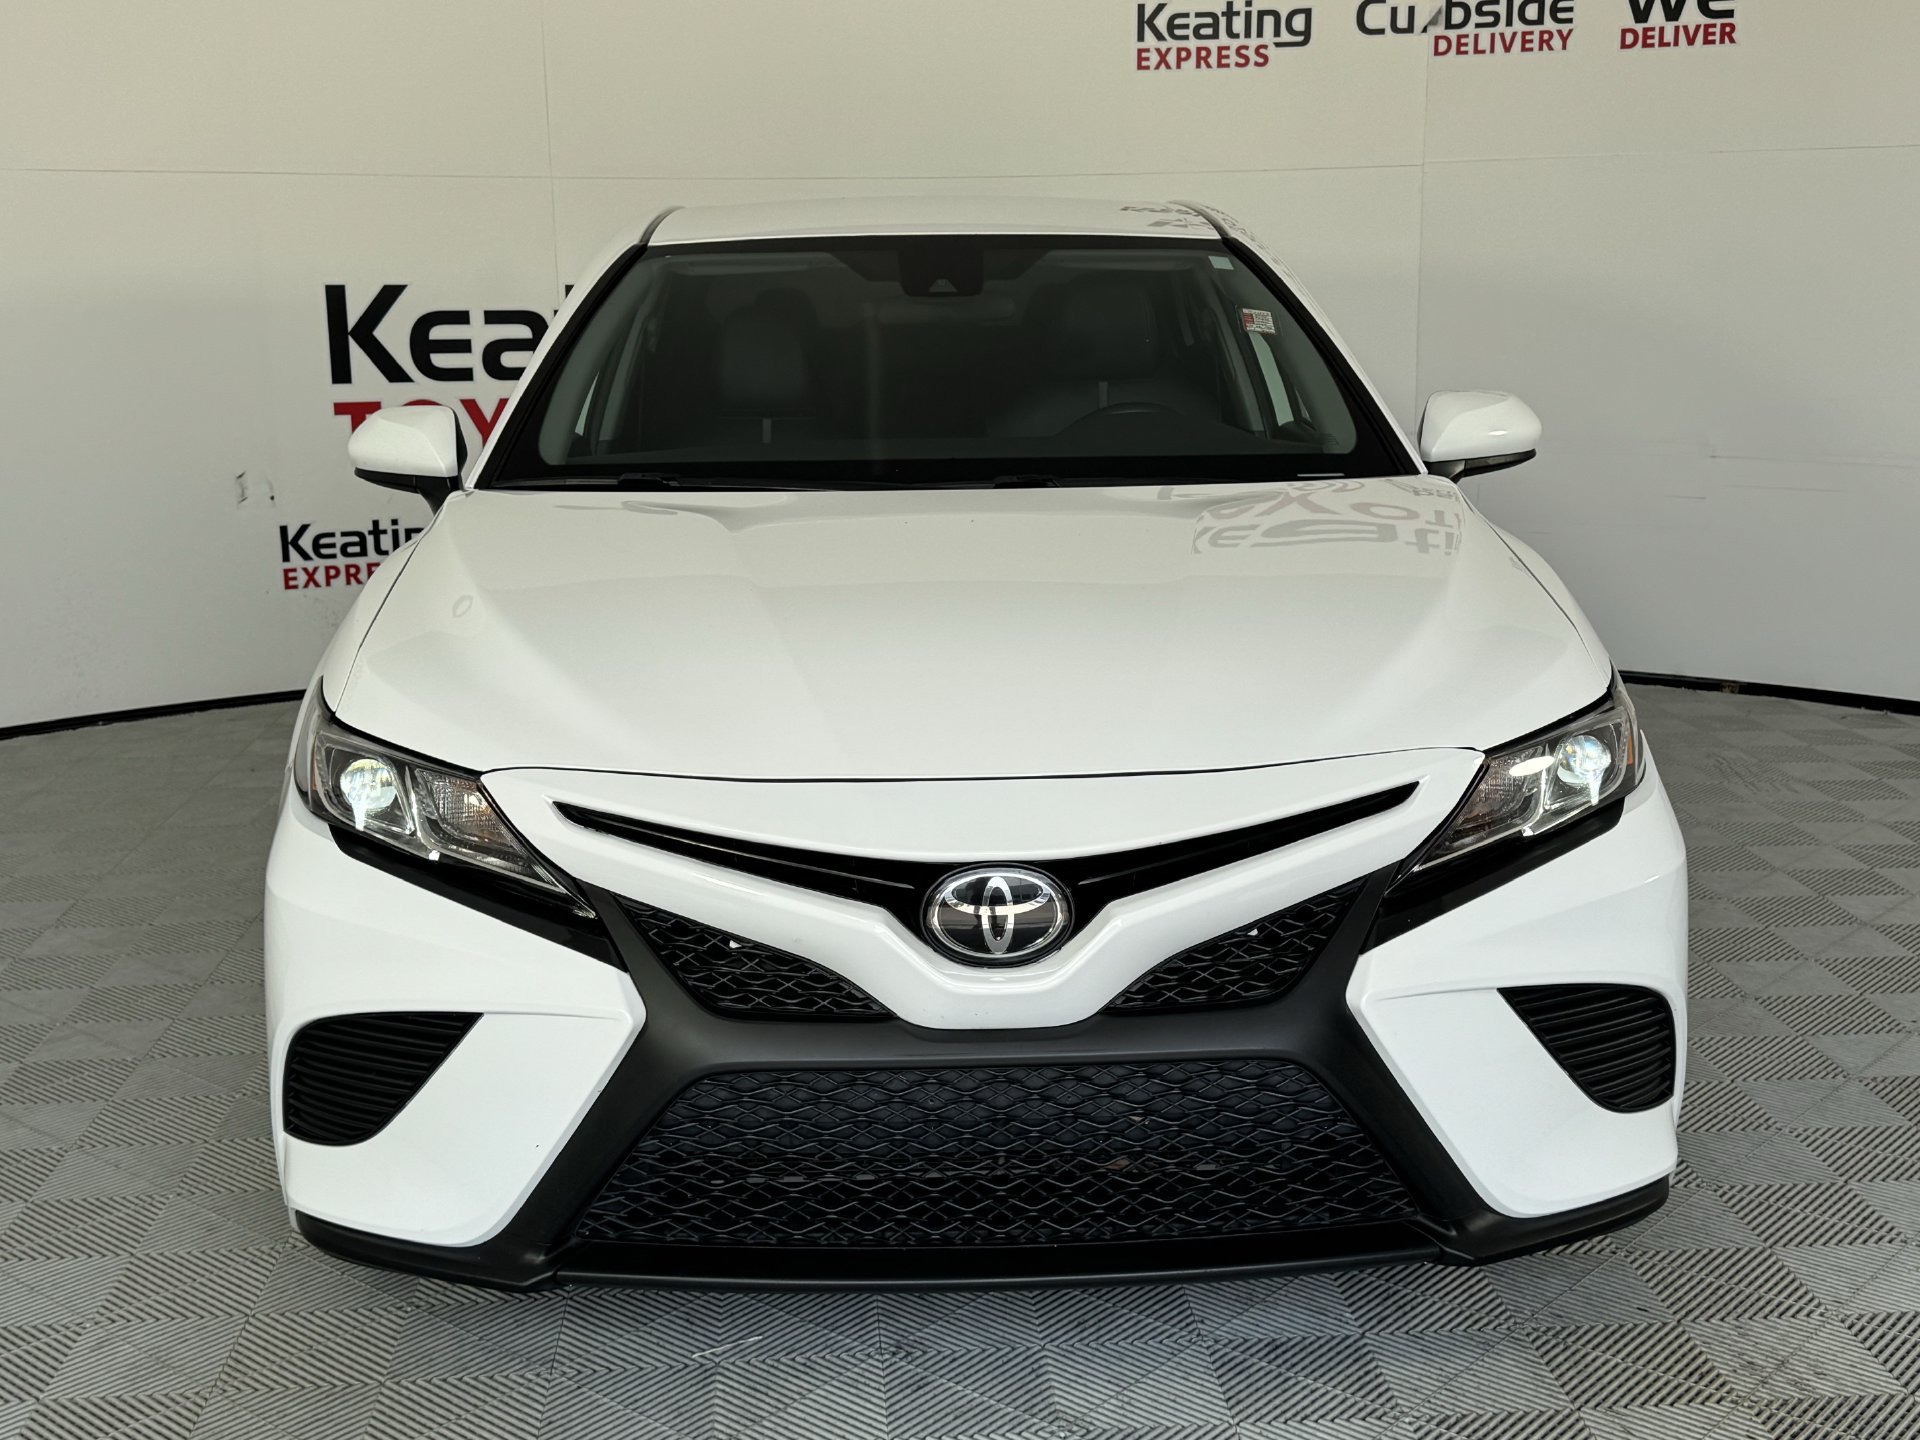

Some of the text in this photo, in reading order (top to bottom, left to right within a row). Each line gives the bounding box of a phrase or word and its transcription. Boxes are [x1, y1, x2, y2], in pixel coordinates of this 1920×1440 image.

[1137, 1, 1312, 47] Keating
[1356, 0, 1573, 35] Cubside
[1433, 29, 1573, 56] DELIVERY
[1620, 22, 1736, 49] DELIVER
[1137, 44, 1269, 70] EXPRESS
[325, 284, 574, 384] Kea
